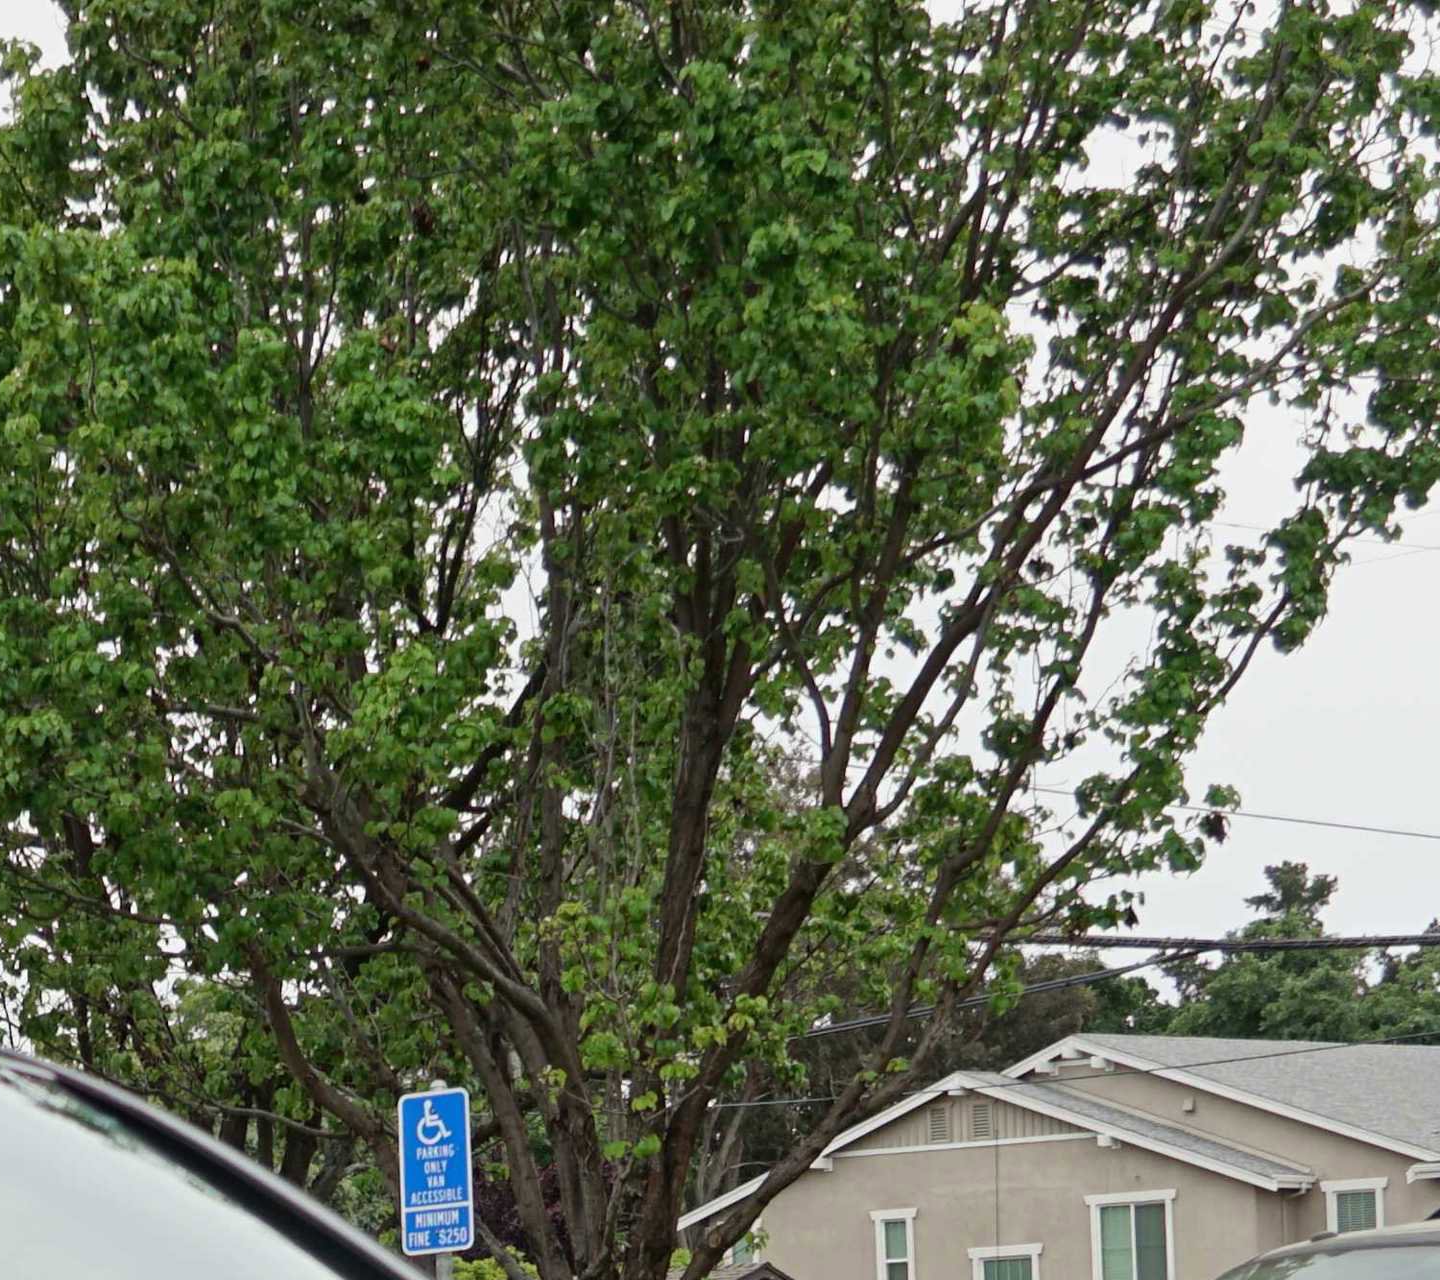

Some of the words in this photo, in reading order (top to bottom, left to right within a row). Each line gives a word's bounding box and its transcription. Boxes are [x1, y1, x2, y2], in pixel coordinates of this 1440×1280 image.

[416, 1143, 455, 1160] PARKING
[423, 1160, 447, 1174] ONLY
[426, 1175, 445, 1188] VAN
[411, 1186, 463, 1204] ACCESSIBLE
[415, 1210, 459, 1229] MINIMUM
[408, 1230, 430, 1248] FINE
[436, 1227, 467, 1245] $250
